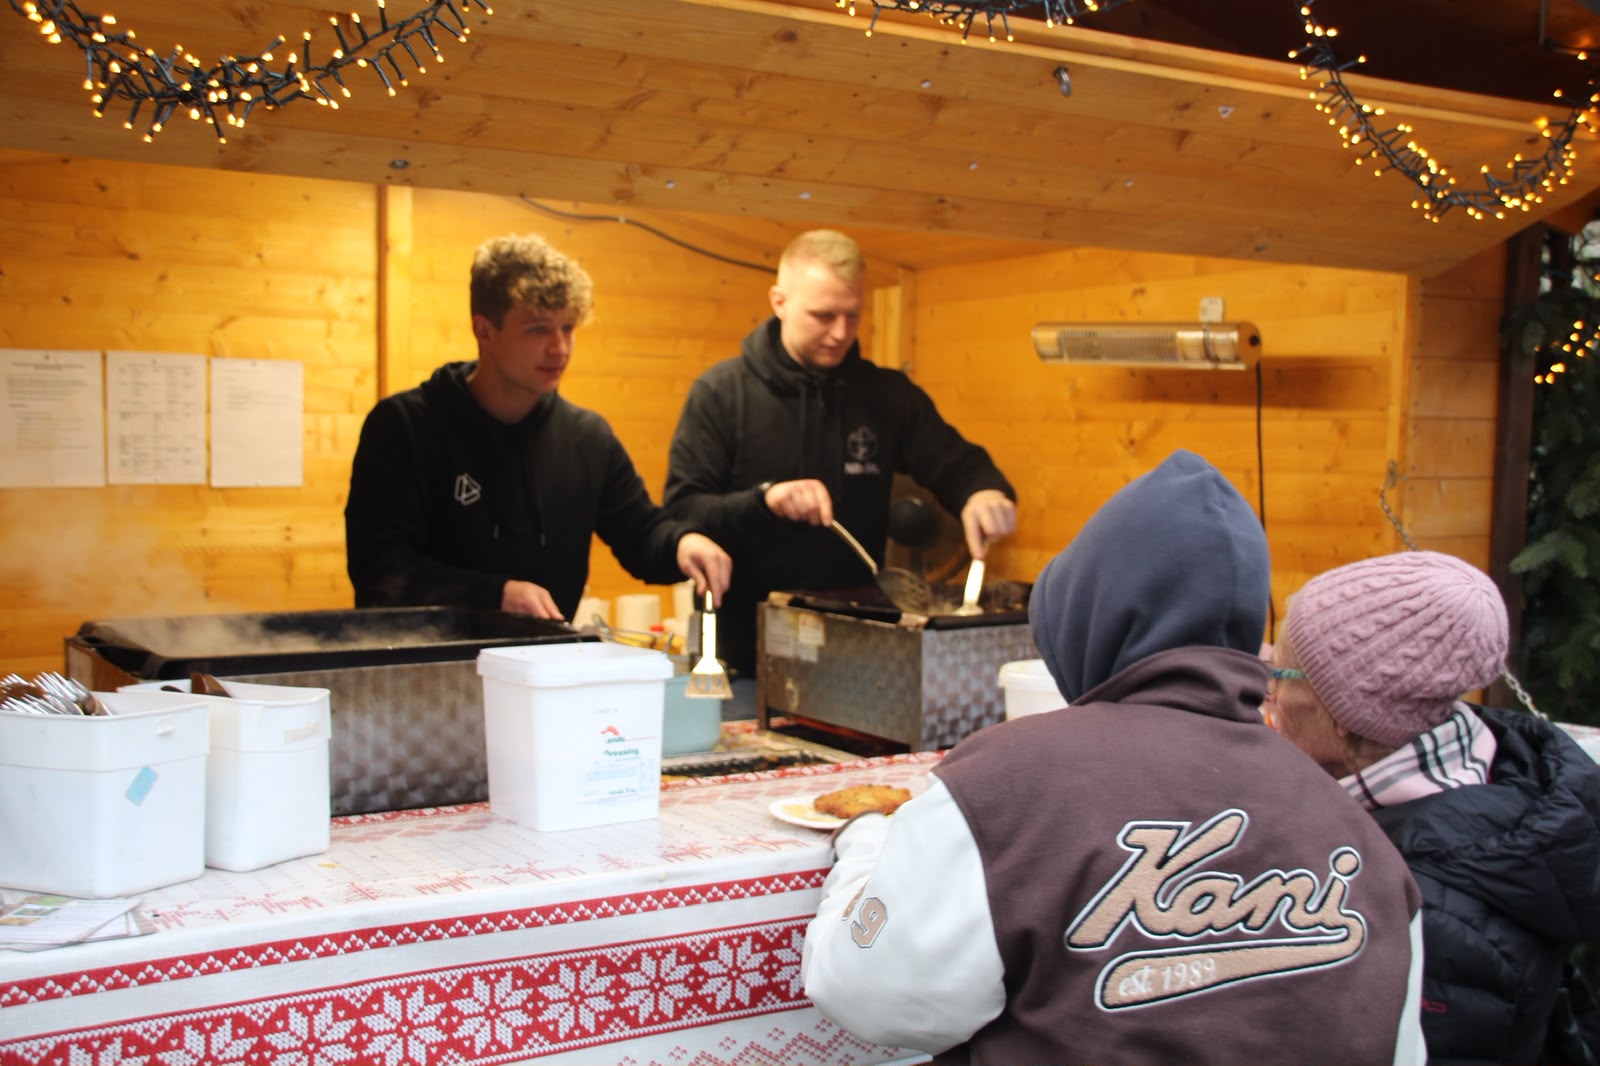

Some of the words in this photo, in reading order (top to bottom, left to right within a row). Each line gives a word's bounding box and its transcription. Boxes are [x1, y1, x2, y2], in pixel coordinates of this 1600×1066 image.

[1064, 808, 1365, 950] Kani
[1118, 965, 1154, 996] est
[1161, 957, 1216, 991] 1989
